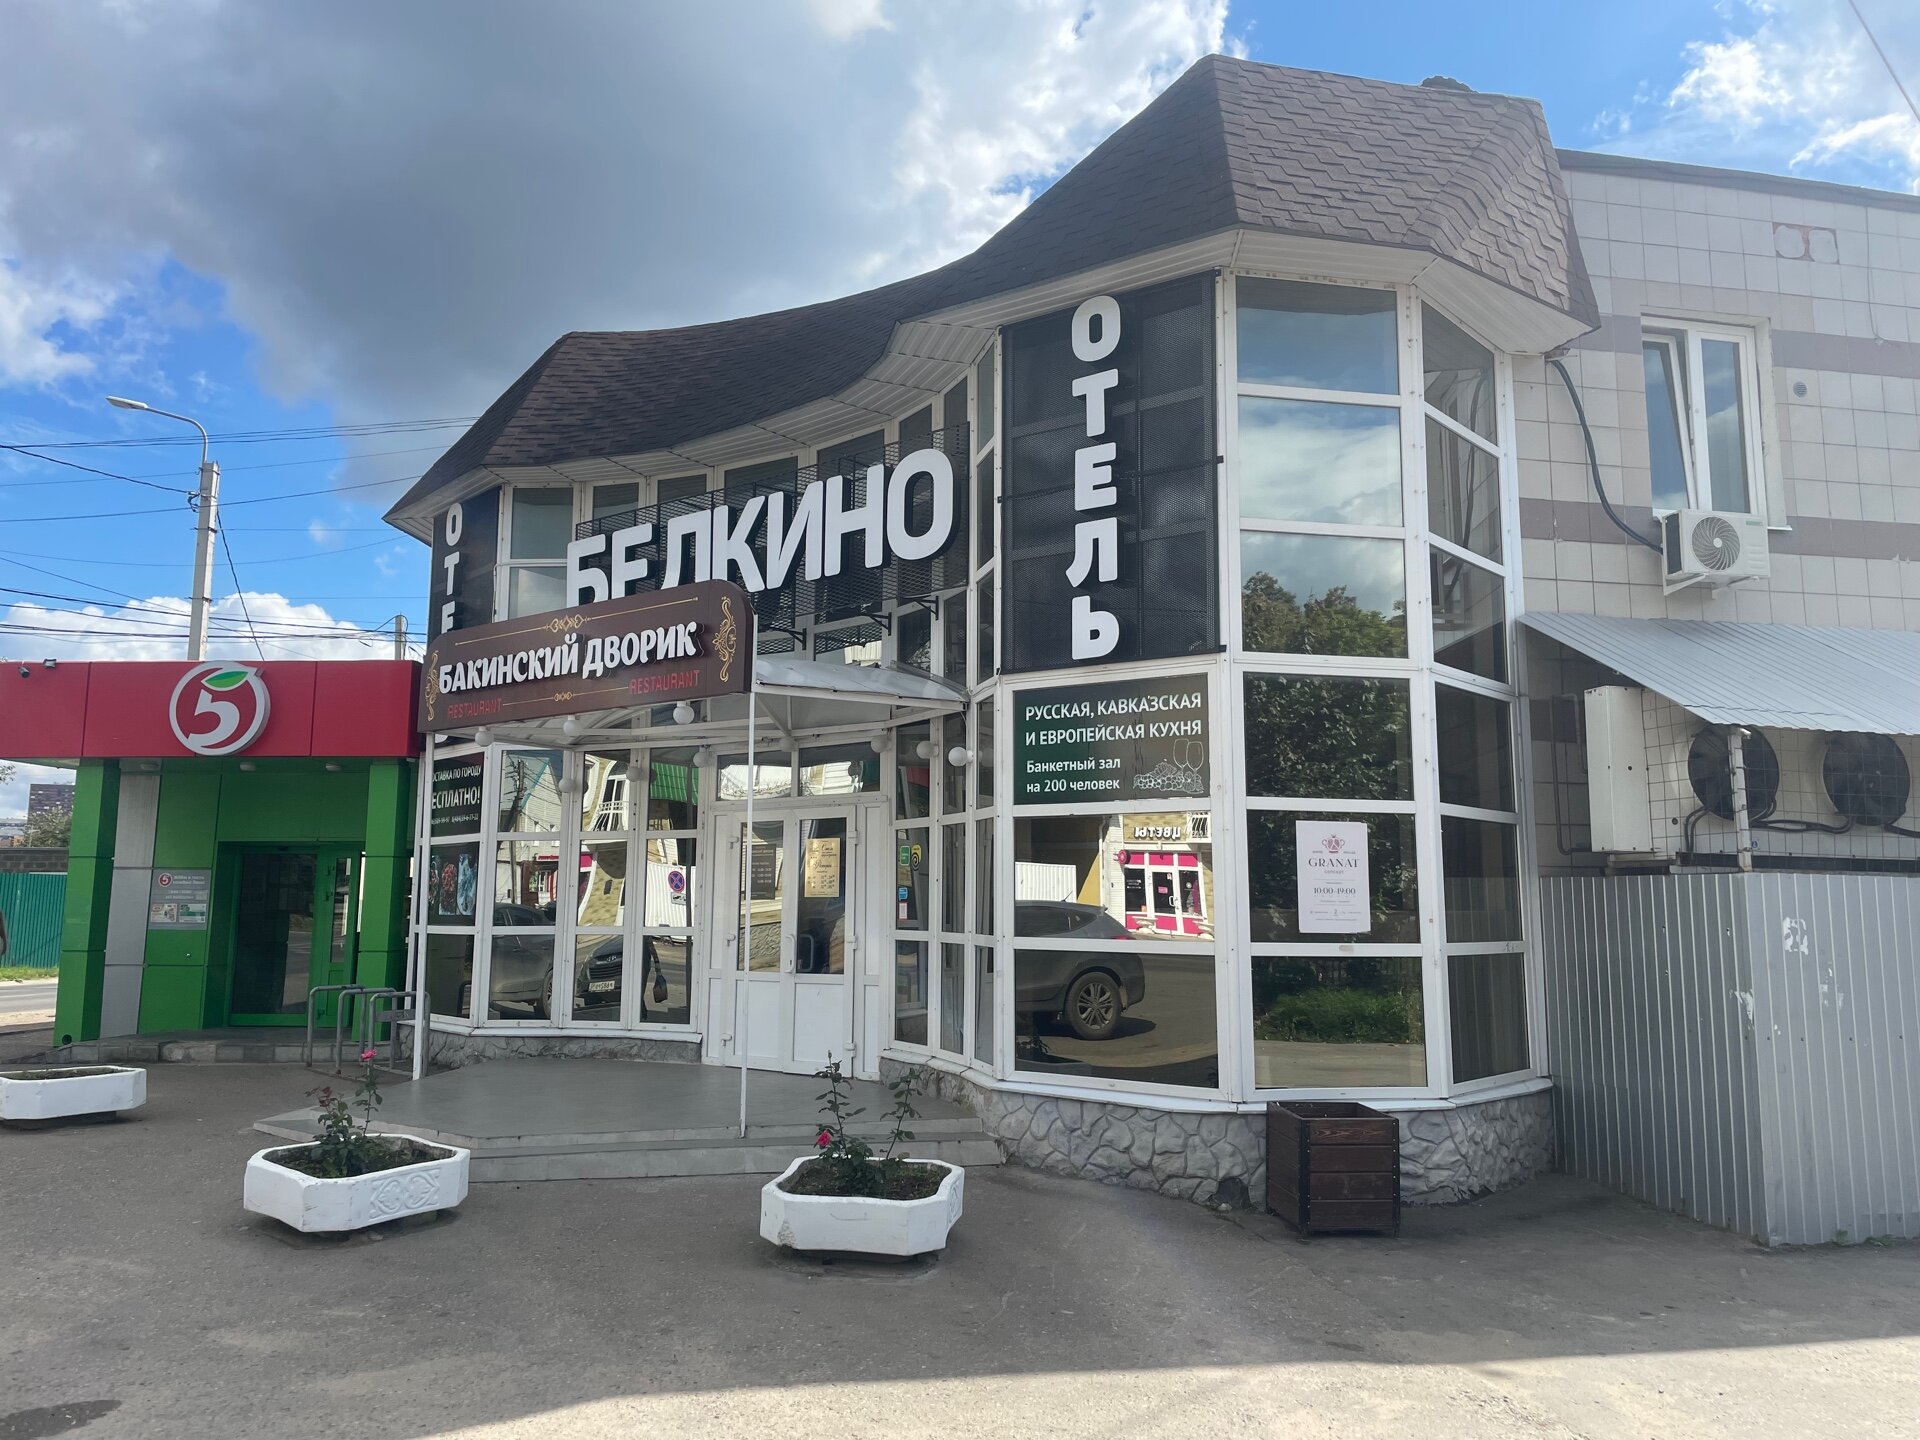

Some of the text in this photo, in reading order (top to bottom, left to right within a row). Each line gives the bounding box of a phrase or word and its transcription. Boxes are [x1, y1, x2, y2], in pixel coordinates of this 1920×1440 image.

[1065, 295, 1121, 661] ОТЕЛЬ
[566, 448, 954, 607] БЕЛКИНО
[441, 502, 463, 634] ОТЕ
[439, 621, 698, 694] БАКИНСКИЙ ДВОРИК
[628, 669, 701, 695] RESTAURANT
[447, 698, 502, 720] RESTAURANT
[1026, 692, 1201, 721] РУССКАЯ, КАВКАЗСКАЯ
[1026, 720, 1202, 746] И ЕВРОПЕЙСКАЯ КУХНЯ
[432, 765, 482, 782] СТАВКА ПО ГОРОДУ
[1027, 757, 1121, 773] Банкетный зал
[432, 786, 480, 809] ЕСПЛАТНО!
[1027, 779, 1120, 793] на 200 человек
[1308, 858, 1360, 868] GRANAT
